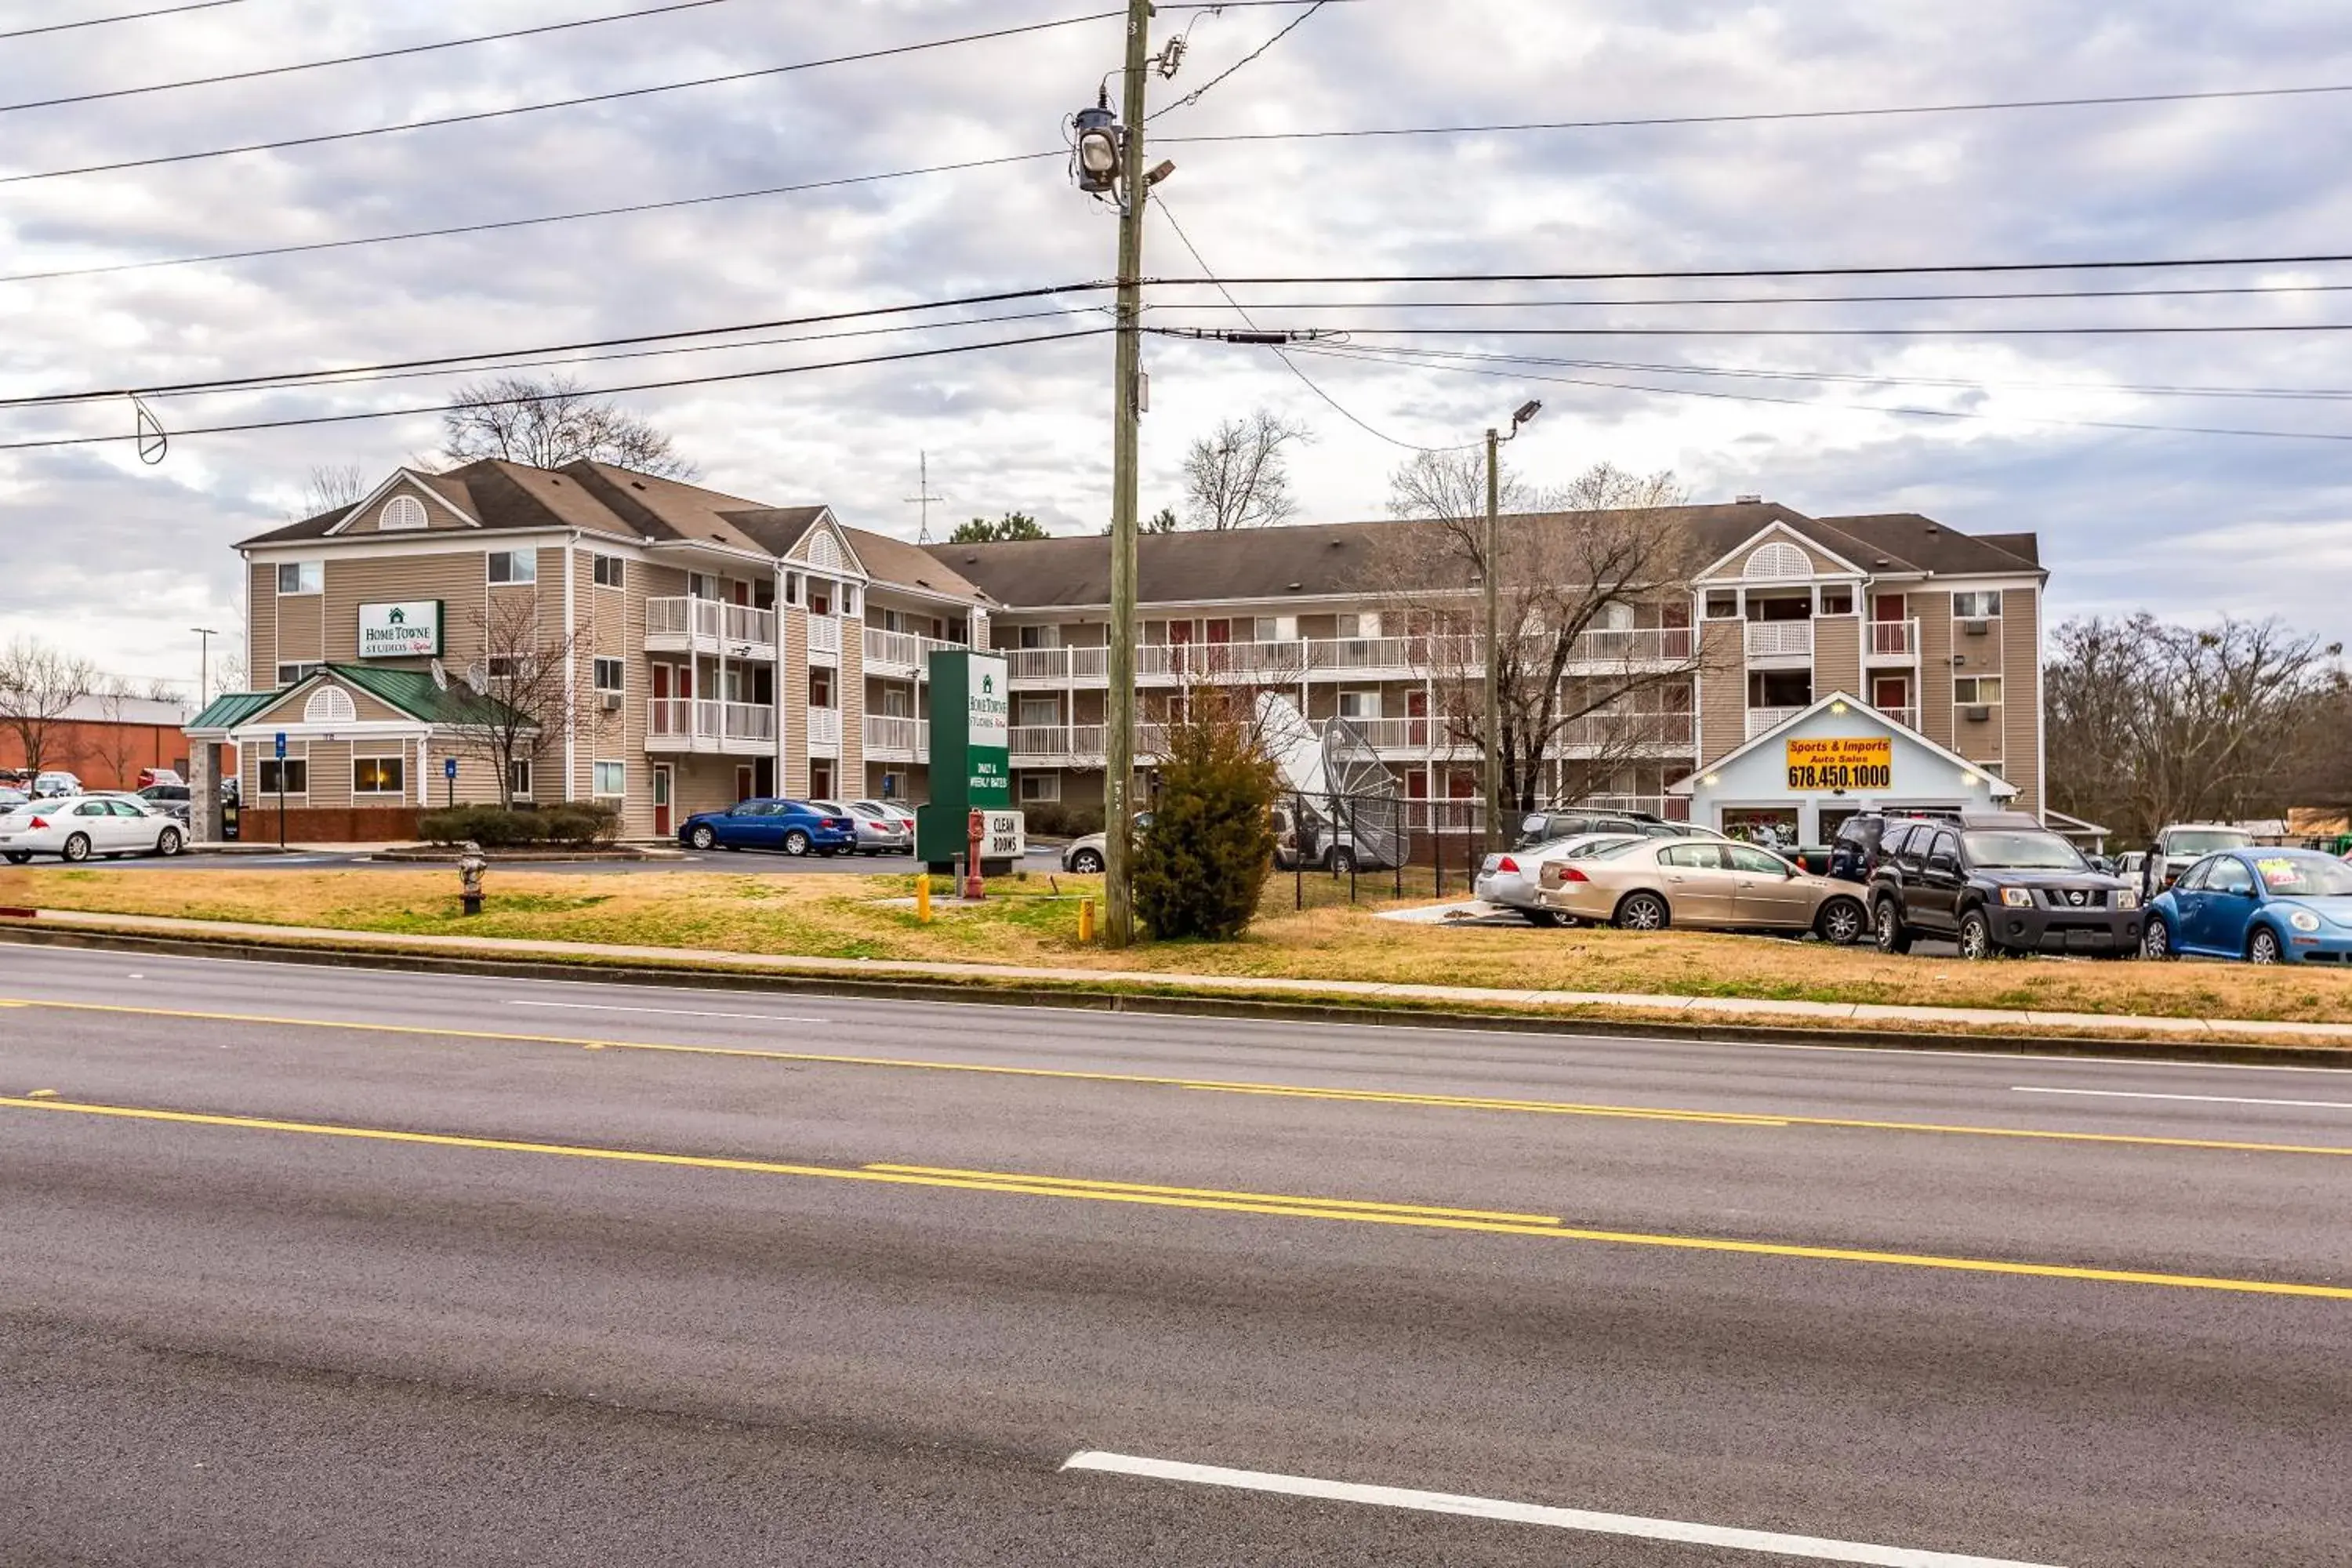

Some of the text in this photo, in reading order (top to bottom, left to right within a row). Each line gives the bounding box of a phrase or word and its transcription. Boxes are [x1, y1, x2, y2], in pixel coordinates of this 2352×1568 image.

[365, 643, 407, 653] STUDIOS
[1790, 739, 1889, 755] Sports & Imports
[1788, 764, 1890, 787] 678.450.1000
[993, 818, 1015, 832] CLEAN
[993, 836, 1017, 852] ROOMS
